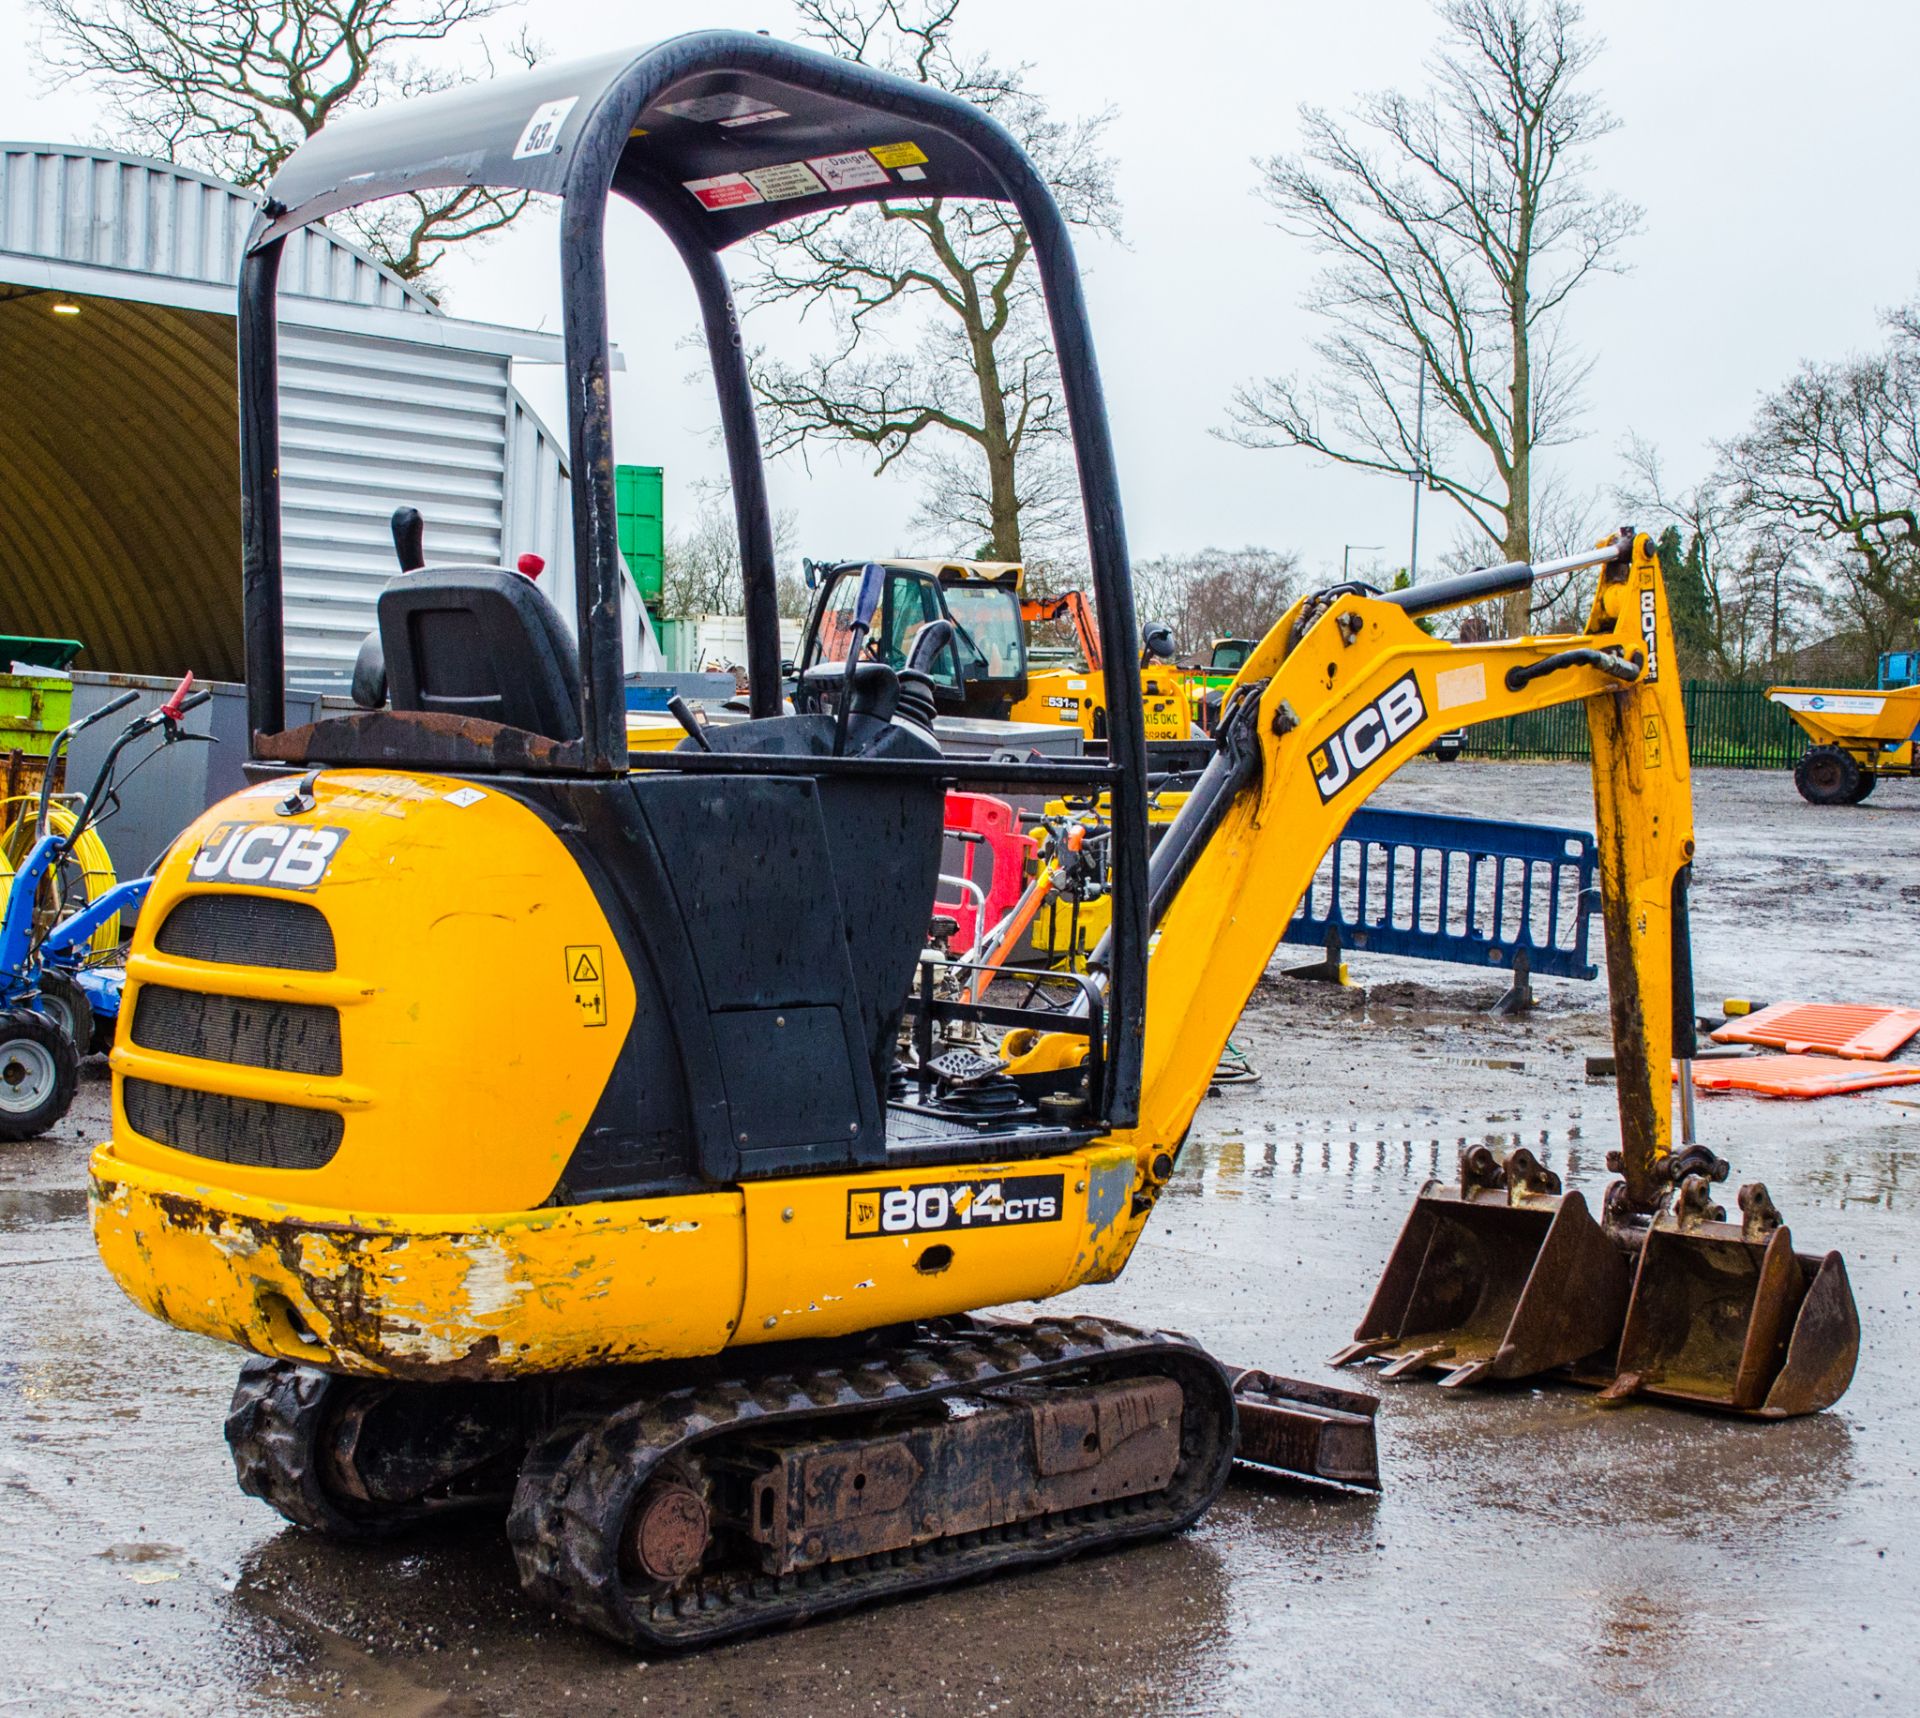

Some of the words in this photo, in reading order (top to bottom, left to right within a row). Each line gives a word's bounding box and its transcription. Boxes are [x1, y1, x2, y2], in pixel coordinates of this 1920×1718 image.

[523, 121, 553, 152] 93
[828, 154, 870, 166] Danger
[1318, 678, 1423, 796] JCB
[194, 825, 340, 886] JCB
